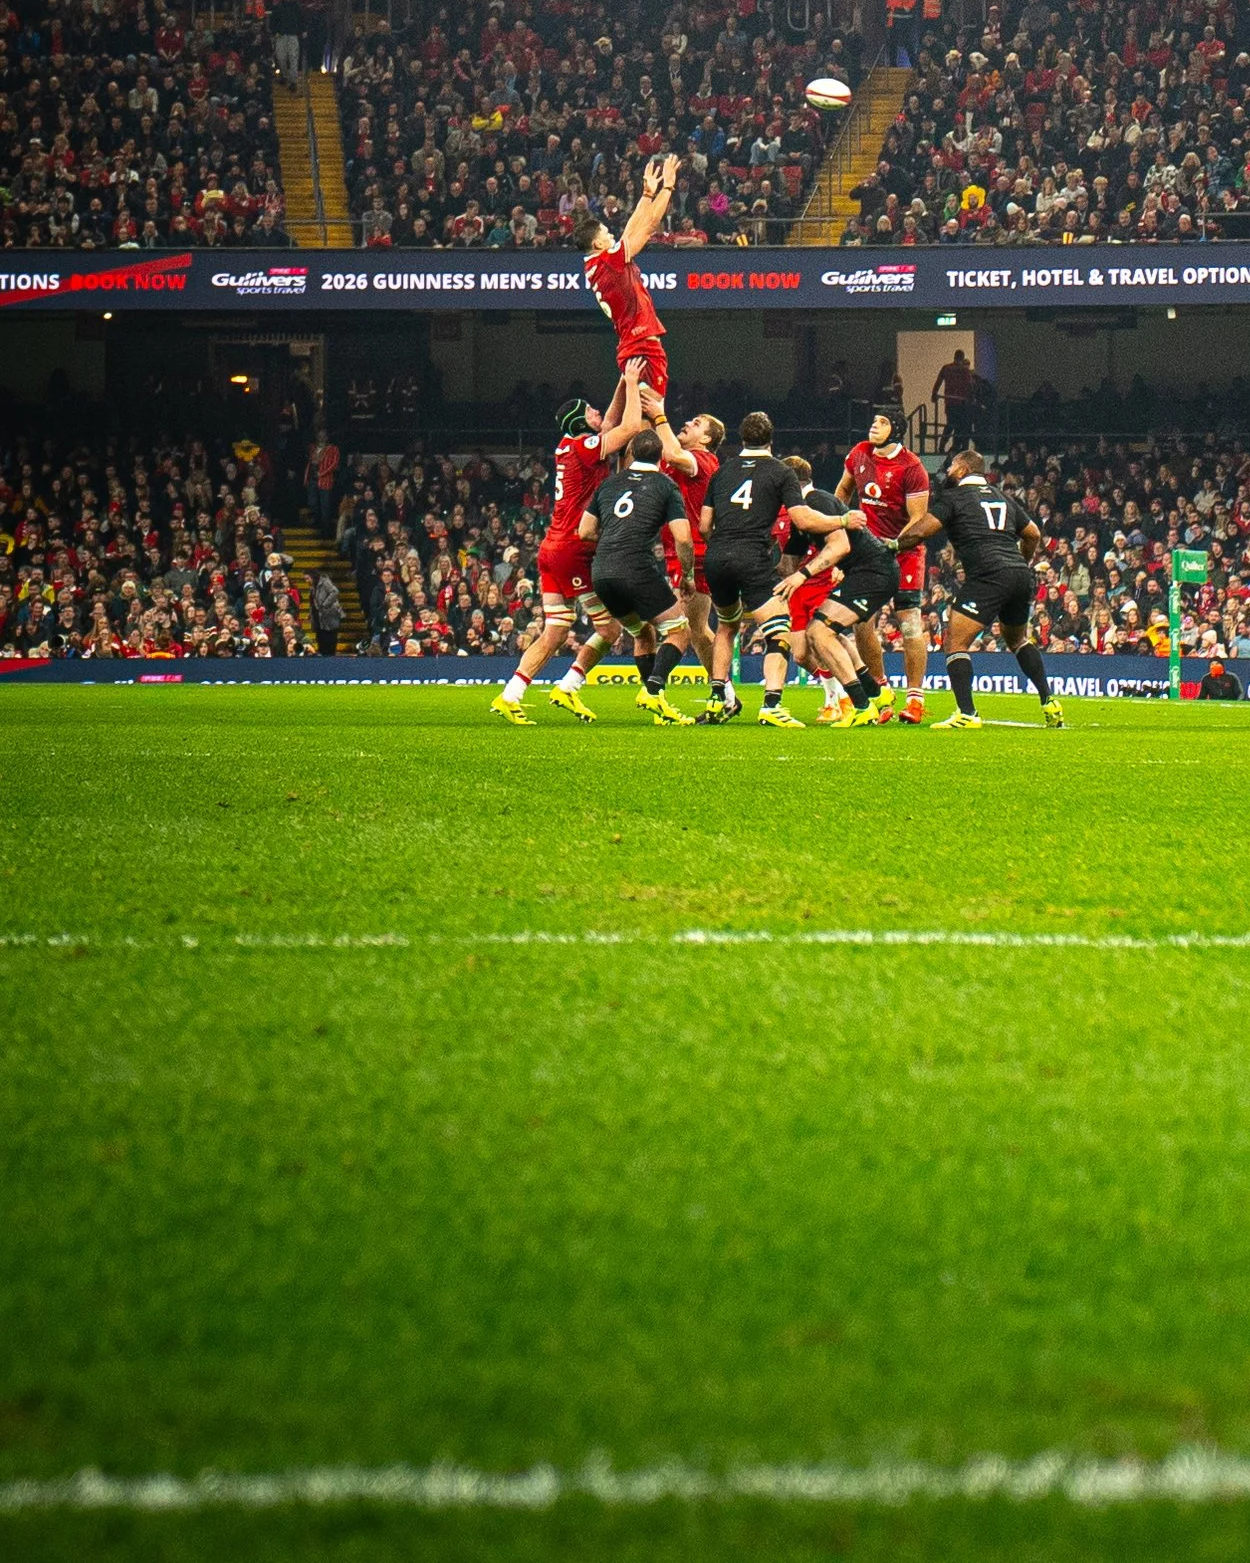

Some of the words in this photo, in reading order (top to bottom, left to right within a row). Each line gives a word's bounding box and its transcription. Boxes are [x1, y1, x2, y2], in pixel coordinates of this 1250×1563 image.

[135, 273, 188, 291] NOW
[321, 273, 368, 290] 2026
[372, 273, 475, 290] GUINNESS
[480, 273, 543, 290] MEN'S
[546, 273, 580, 290] SIX
[687, 272, 744, 290] BOOK
[750, 271, 801, 290] NOW
[946, 269, 1017, 289] TICKET,
[1022, 268, 1085, 286] HOTEL
[1088, 268, 1105, 286] &
[1107, 267, 1179, 285] TRAVEL
[613, 490, 635, 519] 6
[730, 479, 753, 510] 4
[980, 501, 1008, 531] 17
